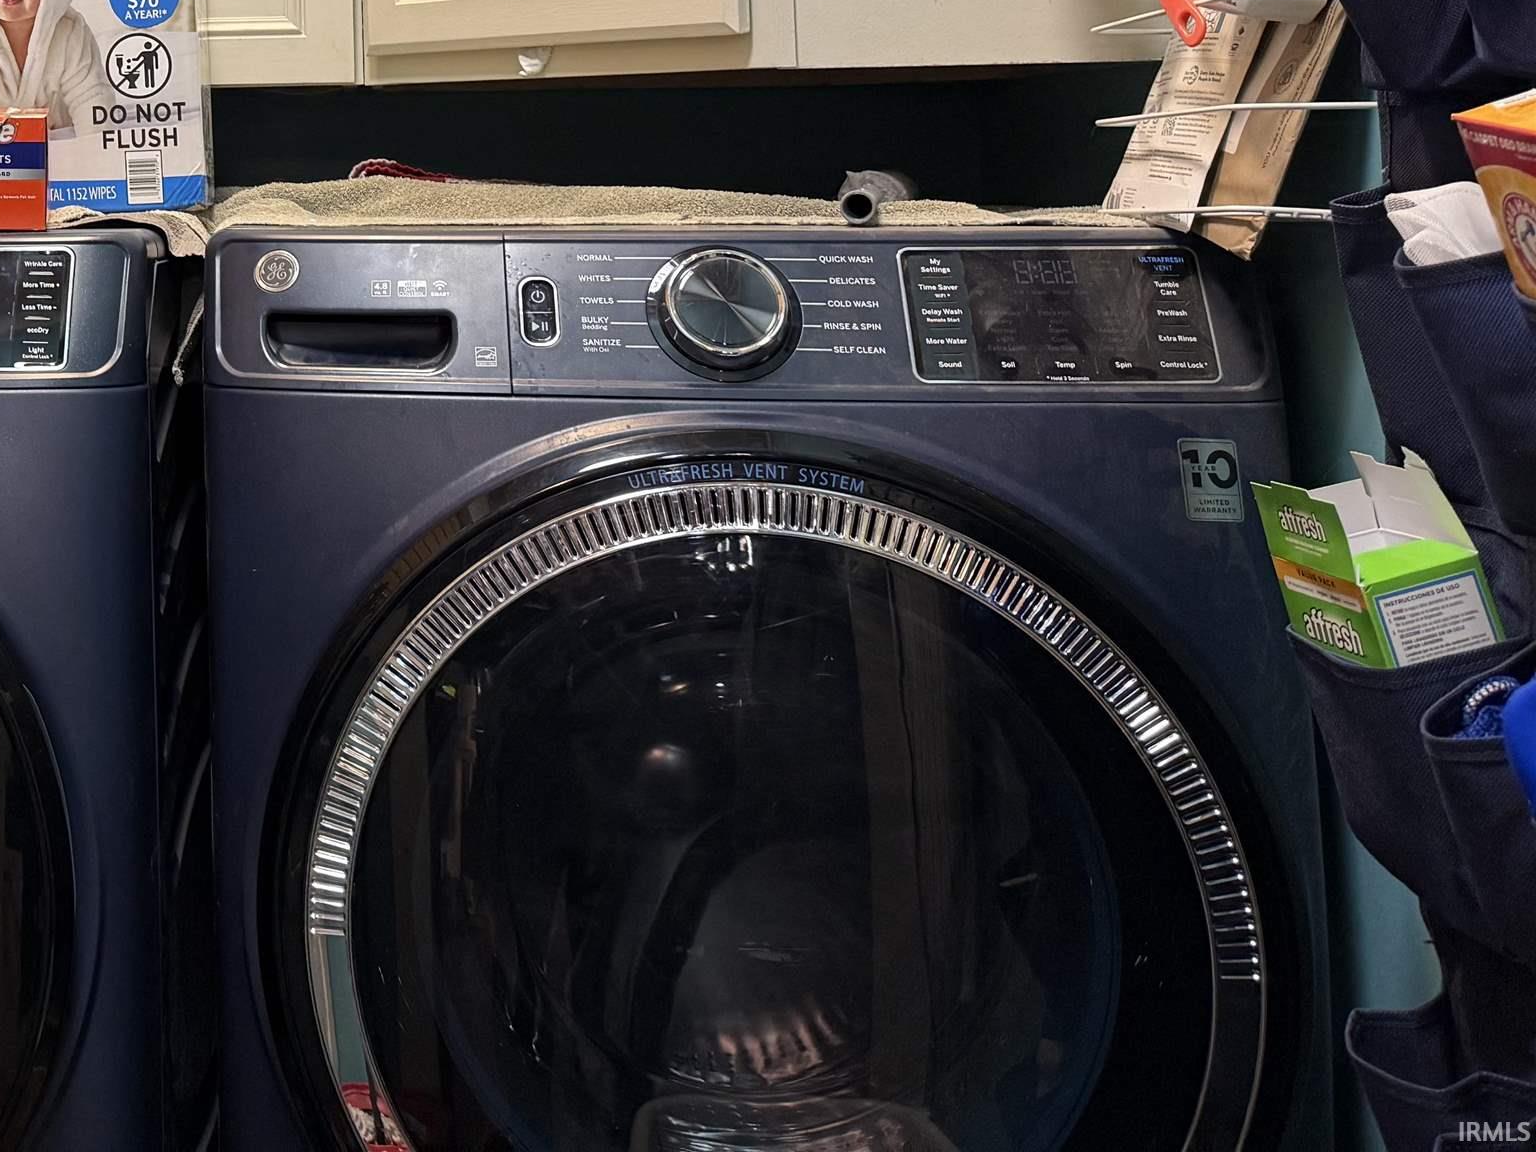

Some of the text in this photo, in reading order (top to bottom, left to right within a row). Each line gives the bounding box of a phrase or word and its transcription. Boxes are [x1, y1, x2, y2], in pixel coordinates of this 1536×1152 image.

[125, 10, 133, 21] A
[92, 100, 187, 126] DO NOT
[102, 126, 179, 149] FLUSH
[65, 186, 88, 201] 1152
[89, 185, 117, 200] WIPES
[576, 254, 613, 262] NORMAL
[818, 255, 874, 265] QUICK WASH
[929, 258, 941, 266] My
[1137, 256, 1185, 264] ULTRAFRESH
[23, 260, 47, 268] Wrinkle
[920, 266, 951, 274] Settings
[577, 274, 612, 282] WHITES
[829, 277, 876, 285] DELICATES
[917, 283, 958, 291] Time Saver
[1153, 281, 1180, 289] Tumble
[579, 297, 615, 305] TOWELS
[827, 300, 880, 308] COLD WASH
[921, 308, 963, 317] Delay Wash
[1156, 309, 1188, 317] PreWash
[581, 316, 609, 324] BULKY
[26, 326, 50, 335] ecoDry
[823, 322, 882, 331] RINSE SPIN
[925, 337, 968, 345] More Water
[1157, 334, 1198, 343] Extra Rinse
[582, 339, 622, 347] SANITIZE
[27, 346, 45, 355] Light
[833, 346, 886, 355] SELF CLEAN
[1000, 361, 1016, 369] Soil
[1054, 361, 1076, 369] Temp
[1114, 361, 1133, 370] Spin
[1159, 361, 1187, 369] Control
[1181, 449, 1238, 490] 10
[627, 462, 866, 495] ULTRAFRESH VENT SYSTEM
[1199, 498, 1230, 506] LIMITED
[1193, 506, 1237, 514] WARRANTY
[1277, 504, 1328, 543] affresh
[1383, 588, 1436, 608] INSTRUCCIONES
[1302, 607, 1365, 657] affresh
